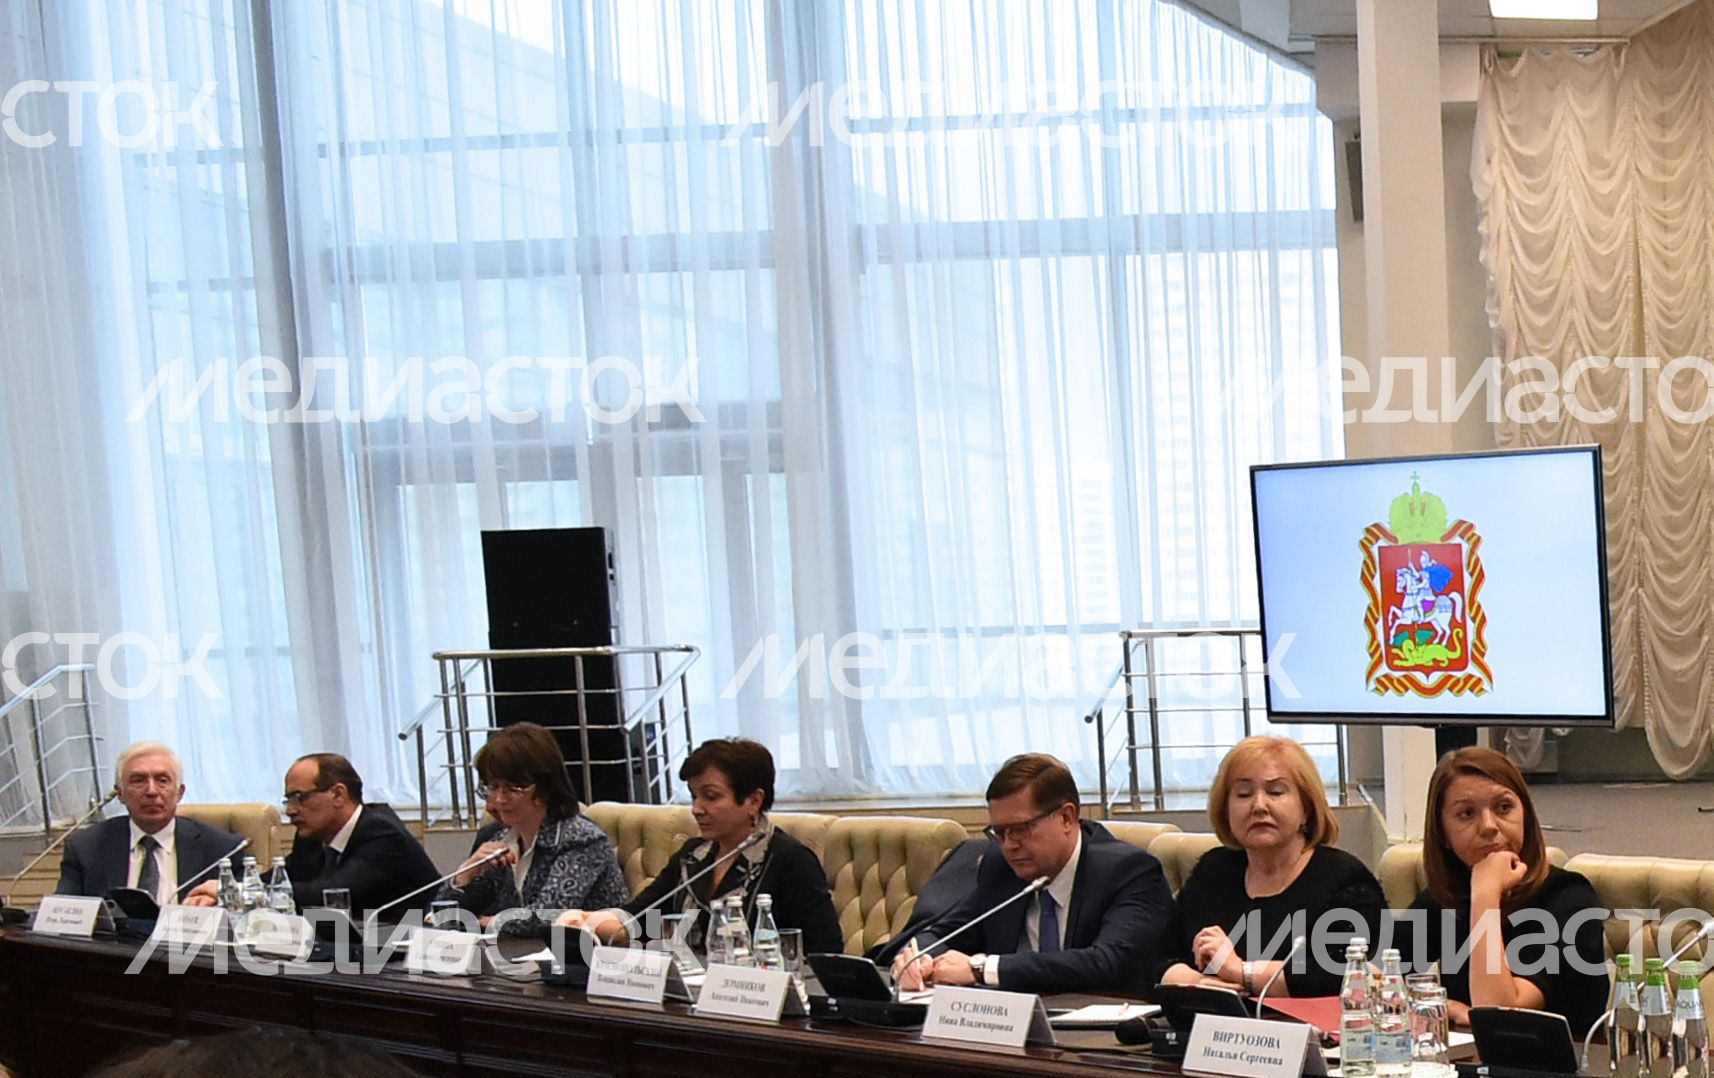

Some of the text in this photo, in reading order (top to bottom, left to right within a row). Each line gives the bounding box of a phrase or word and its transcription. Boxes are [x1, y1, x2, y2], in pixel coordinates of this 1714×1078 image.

[950, 1001, 1008, 1017] СУСЛОНОВА
[1213, 1030, 1281, 1049] ВИРТУОЗОВА
[1203, 1046, 1283, 1066] Наталья Сергеевна
